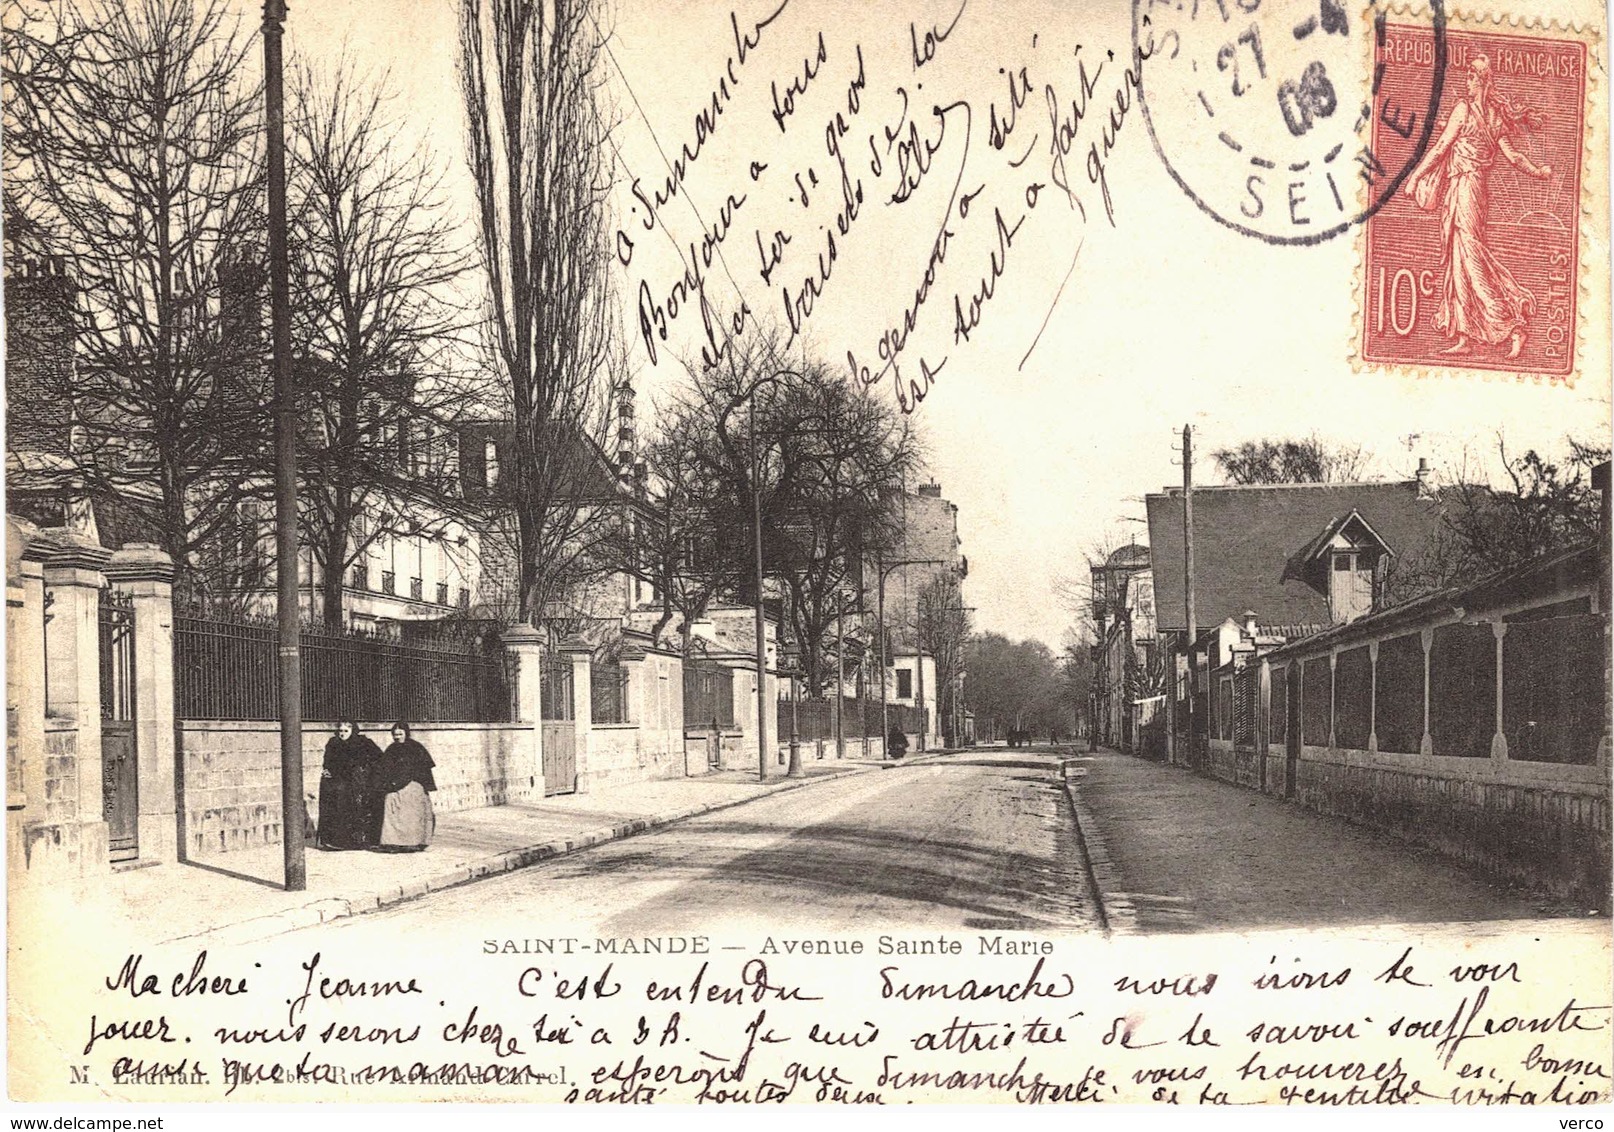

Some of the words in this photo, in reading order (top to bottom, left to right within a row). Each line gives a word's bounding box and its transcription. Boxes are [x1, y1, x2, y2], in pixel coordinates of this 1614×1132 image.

[772, 31, 826, 133] tous
[1545, 252, 1568, 357] POSTES
[762, 935, 865, 955] Avenue
[878, 935, 963, 955] Sainte
[978, 935, 1055, 955] Marie
[879, 956, 1074, 1000] dimanche
[1114, 973, 1219, 998] nous
[320, 1022, 422, 1045] serons
[877, 1055, 1046, 1092] dimanche
[1132, 1064, 1208, 1085] vous
